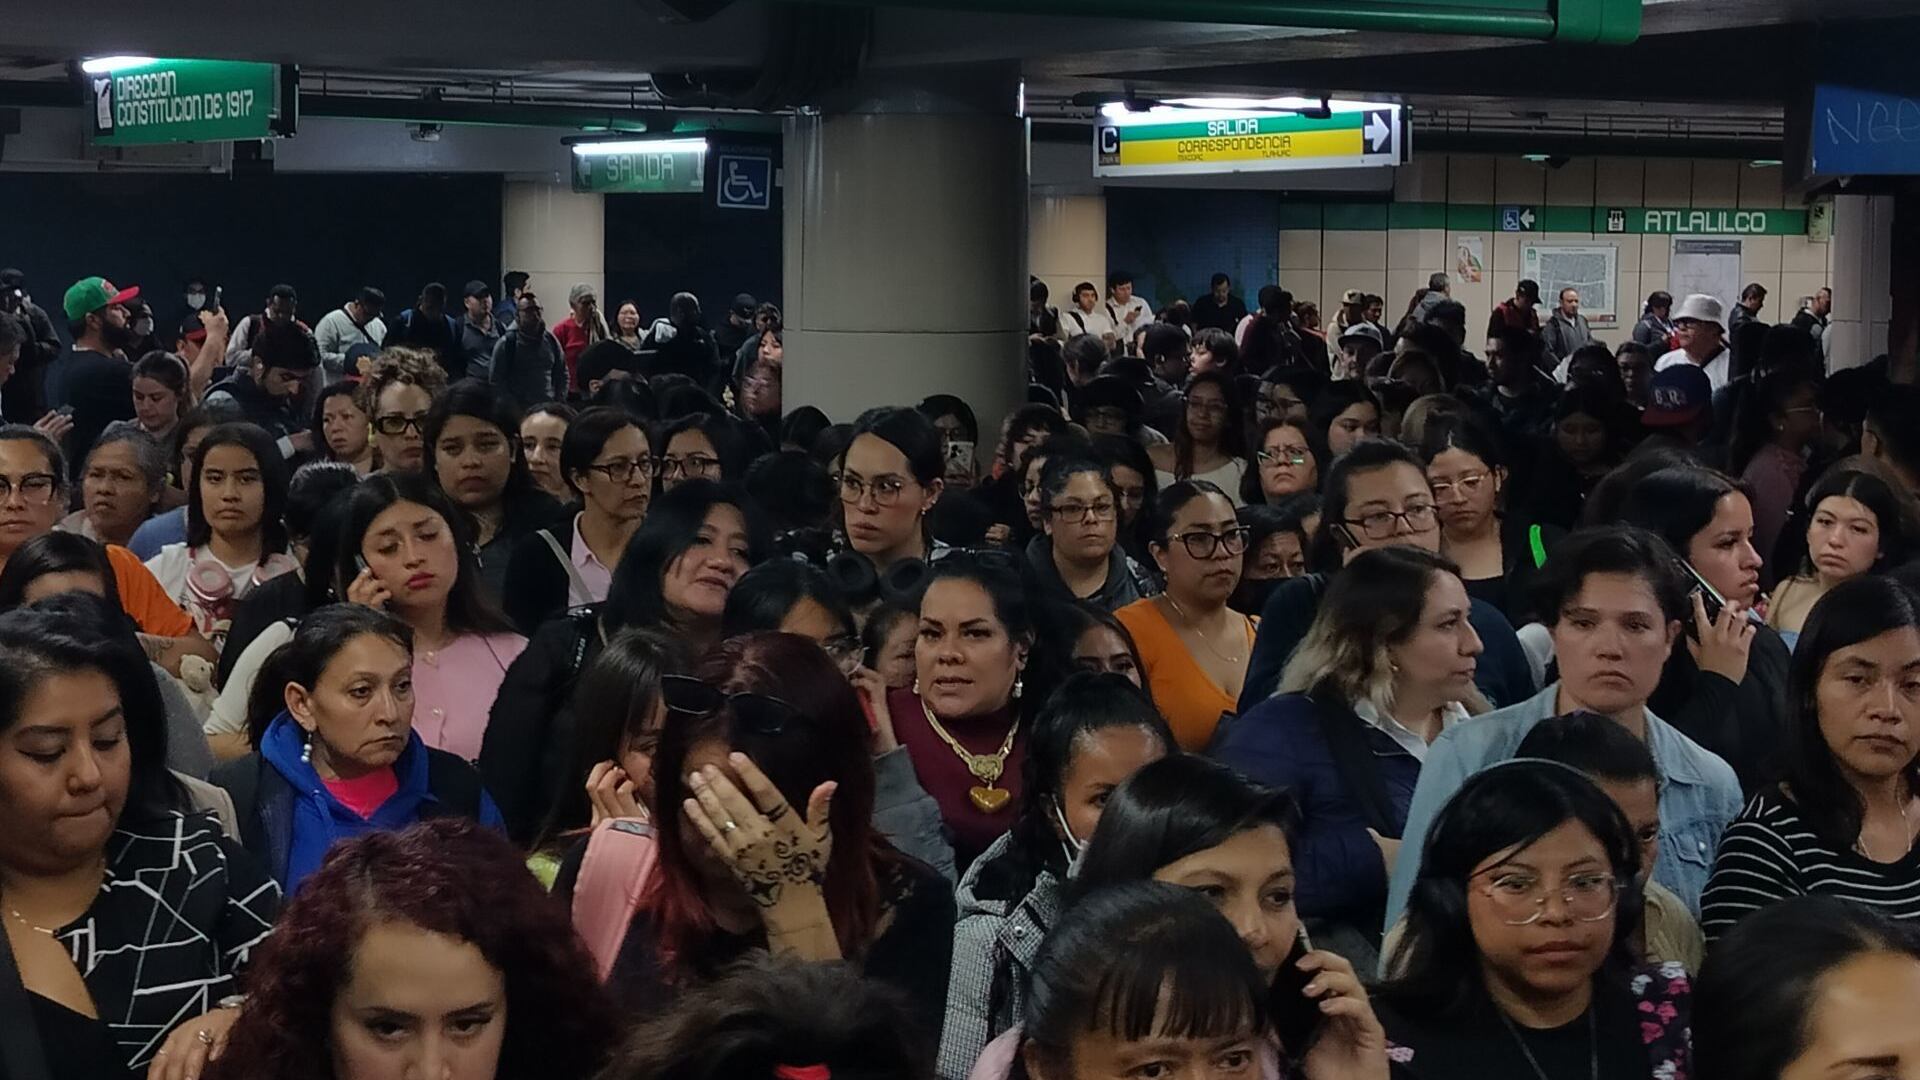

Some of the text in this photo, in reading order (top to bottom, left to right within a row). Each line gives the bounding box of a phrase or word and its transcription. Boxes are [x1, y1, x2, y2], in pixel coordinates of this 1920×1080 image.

[116, 70, 177, 101] DIRECCION
[116, 89, 254, 127] CONSTITUCION DE 1917
[1102, 127, 1118, 154] C
[1207, 118, 1259, 136] SALIDA
[1177, 135, 1291, 154] CORRESPONDENCIA
[606, 153, 675, 181] SALIDA
[1644, 210, 1766, 233] ATLALILCO
